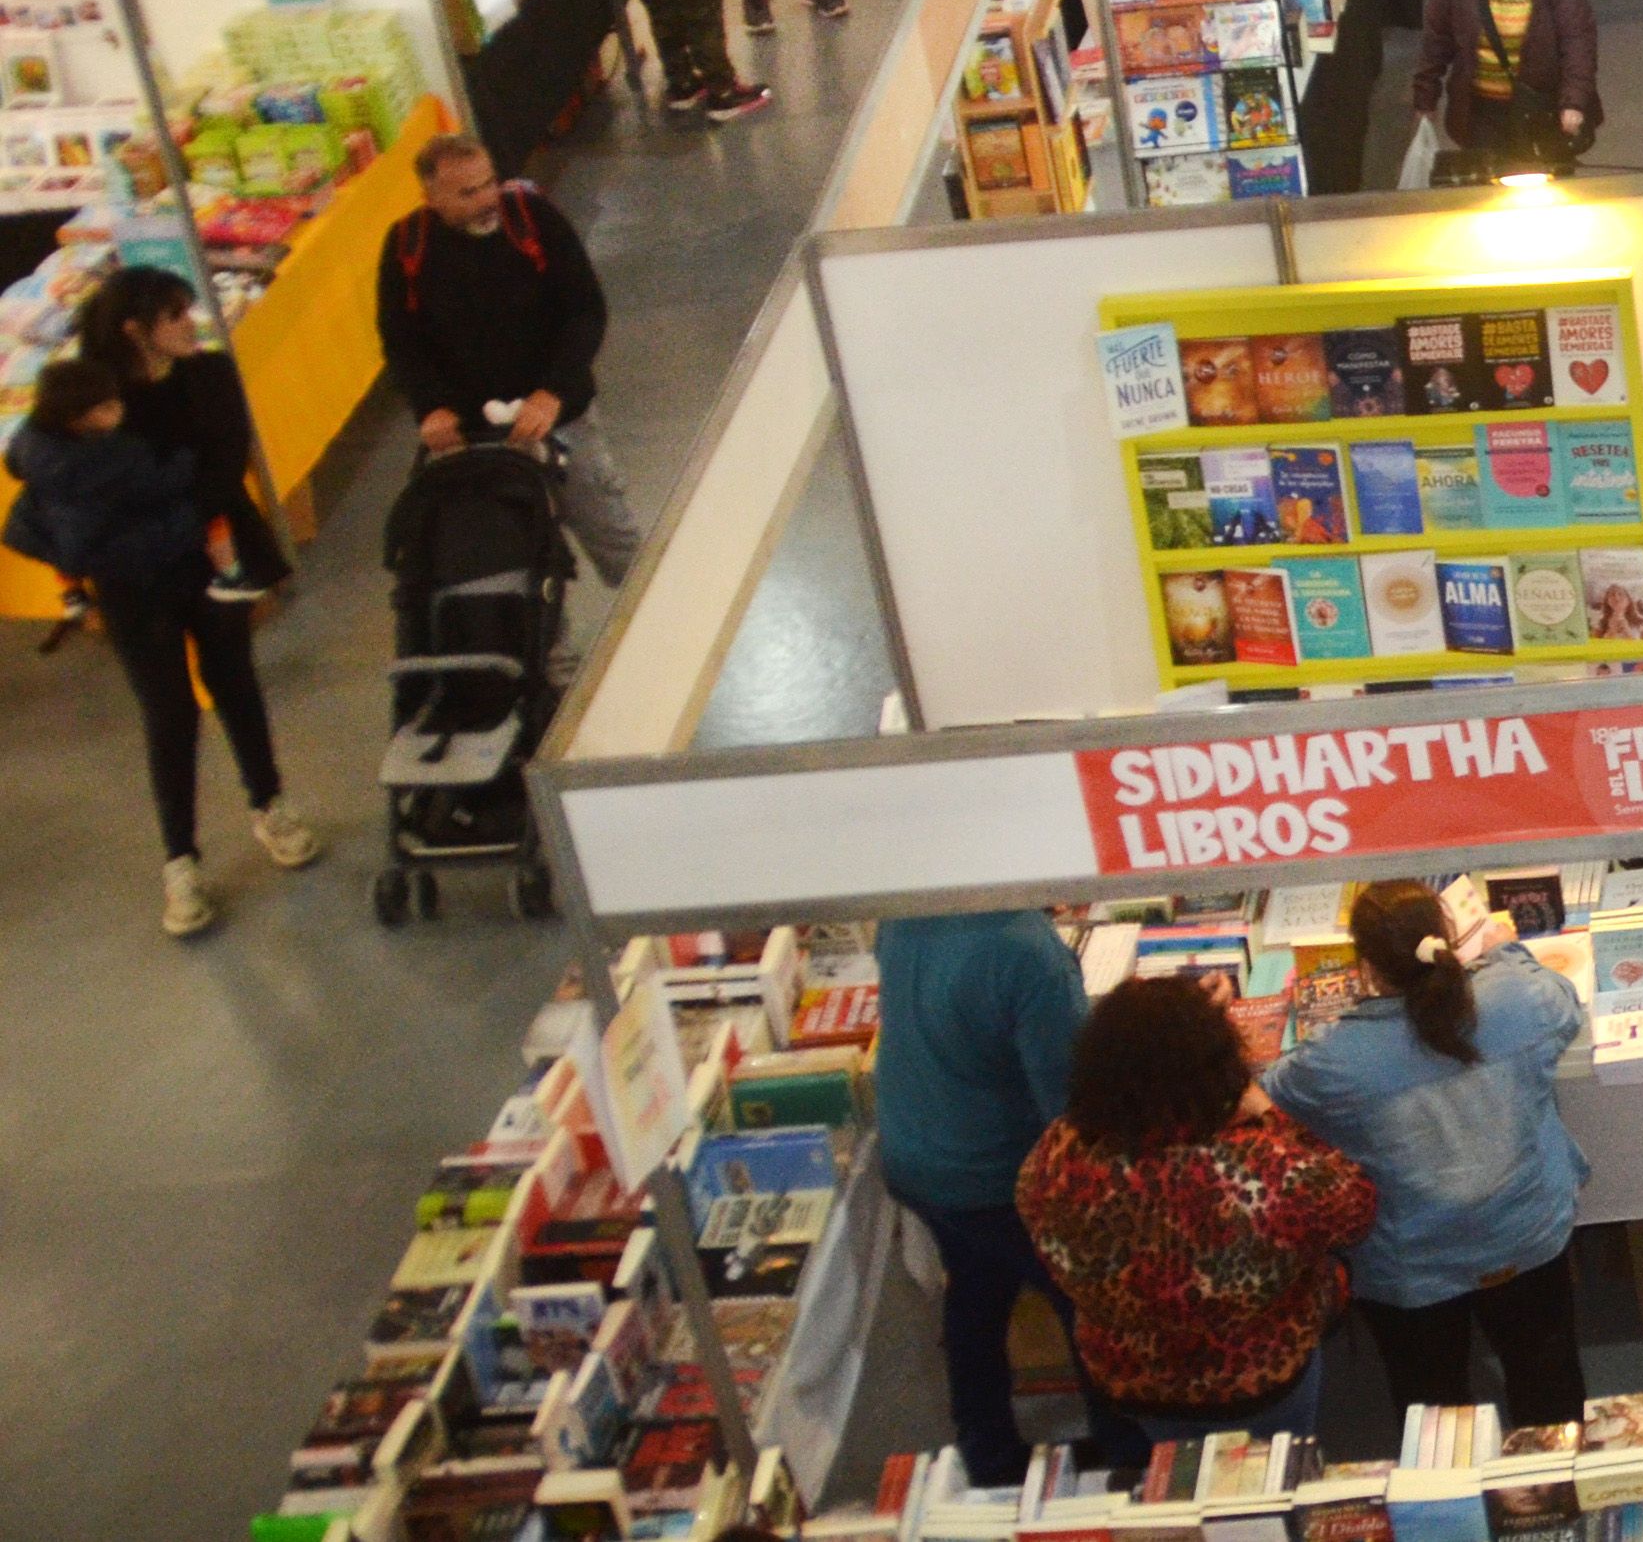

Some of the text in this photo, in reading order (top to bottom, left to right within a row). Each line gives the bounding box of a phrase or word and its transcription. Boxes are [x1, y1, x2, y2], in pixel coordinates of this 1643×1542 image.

[1560, 327, 1613, 340] AMORES
[1109, 338, 1165, 379] FUERTE
[1117, 378, 1176, 408] NUNCA
[1422, 474, 1478, 489] AHORA
[1446, 580, 1502, 607] ALMA
[1110, 717, 1548, 807] SIDDHARTHA
[1118, 798, 1351, 869] LIBROS
